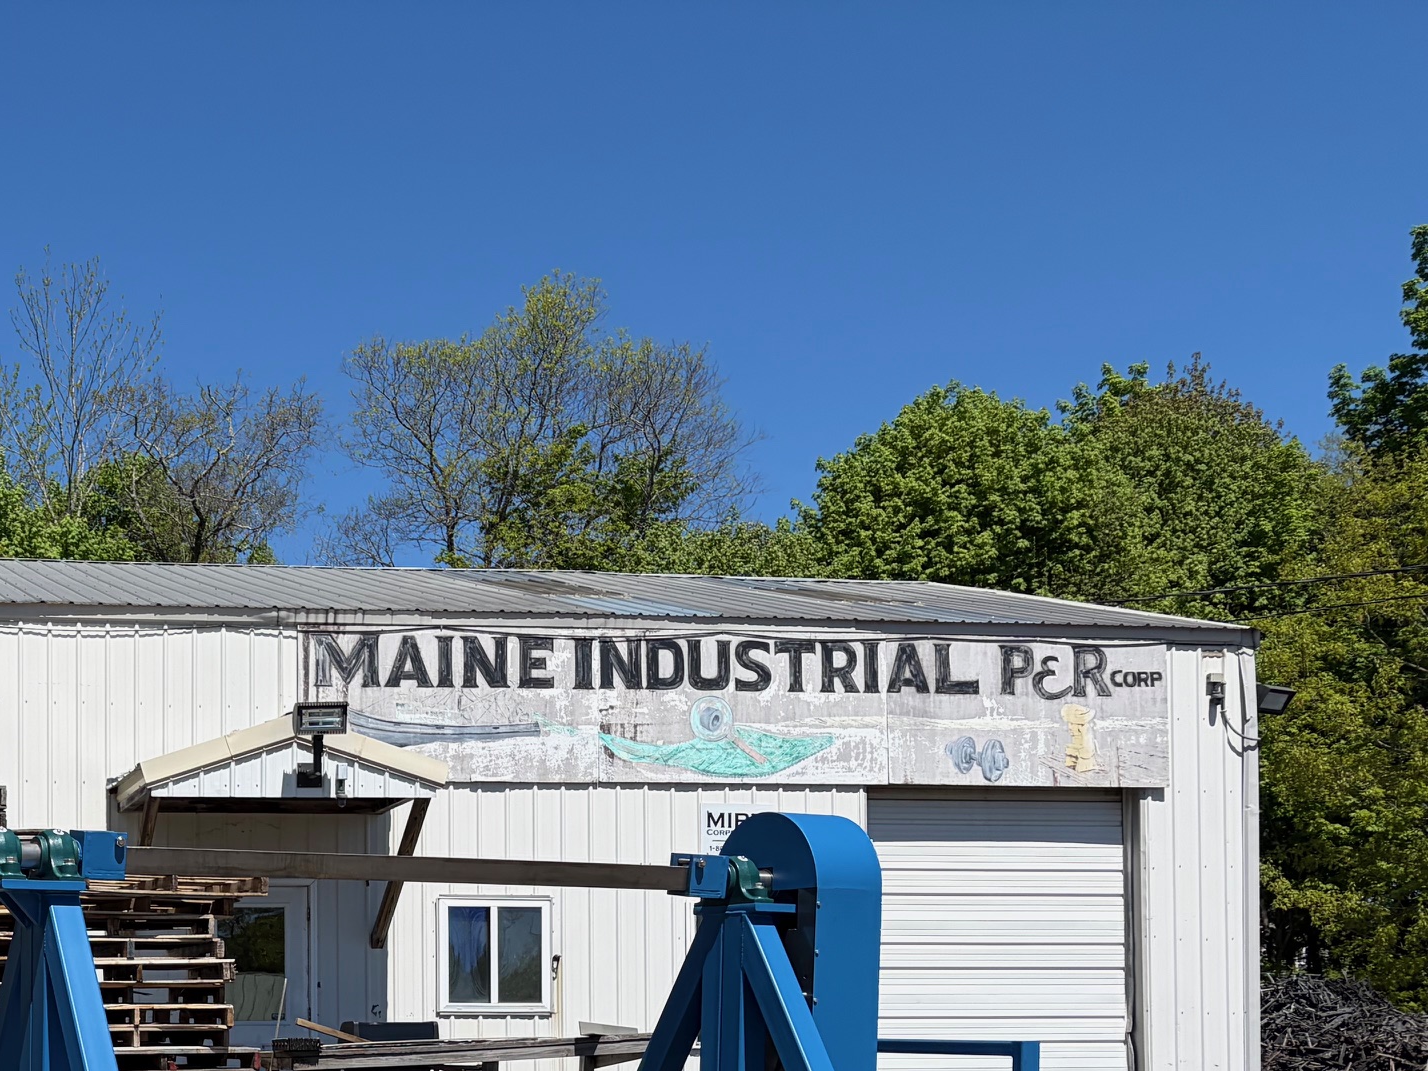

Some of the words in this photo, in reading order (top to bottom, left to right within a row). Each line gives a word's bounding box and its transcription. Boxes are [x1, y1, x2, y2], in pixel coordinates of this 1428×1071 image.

[310, 633, 555, 689] MAINE
[572, 636, 980, 695] INDUSTRIAL
[1109, 669, 1163, 688] CORP
